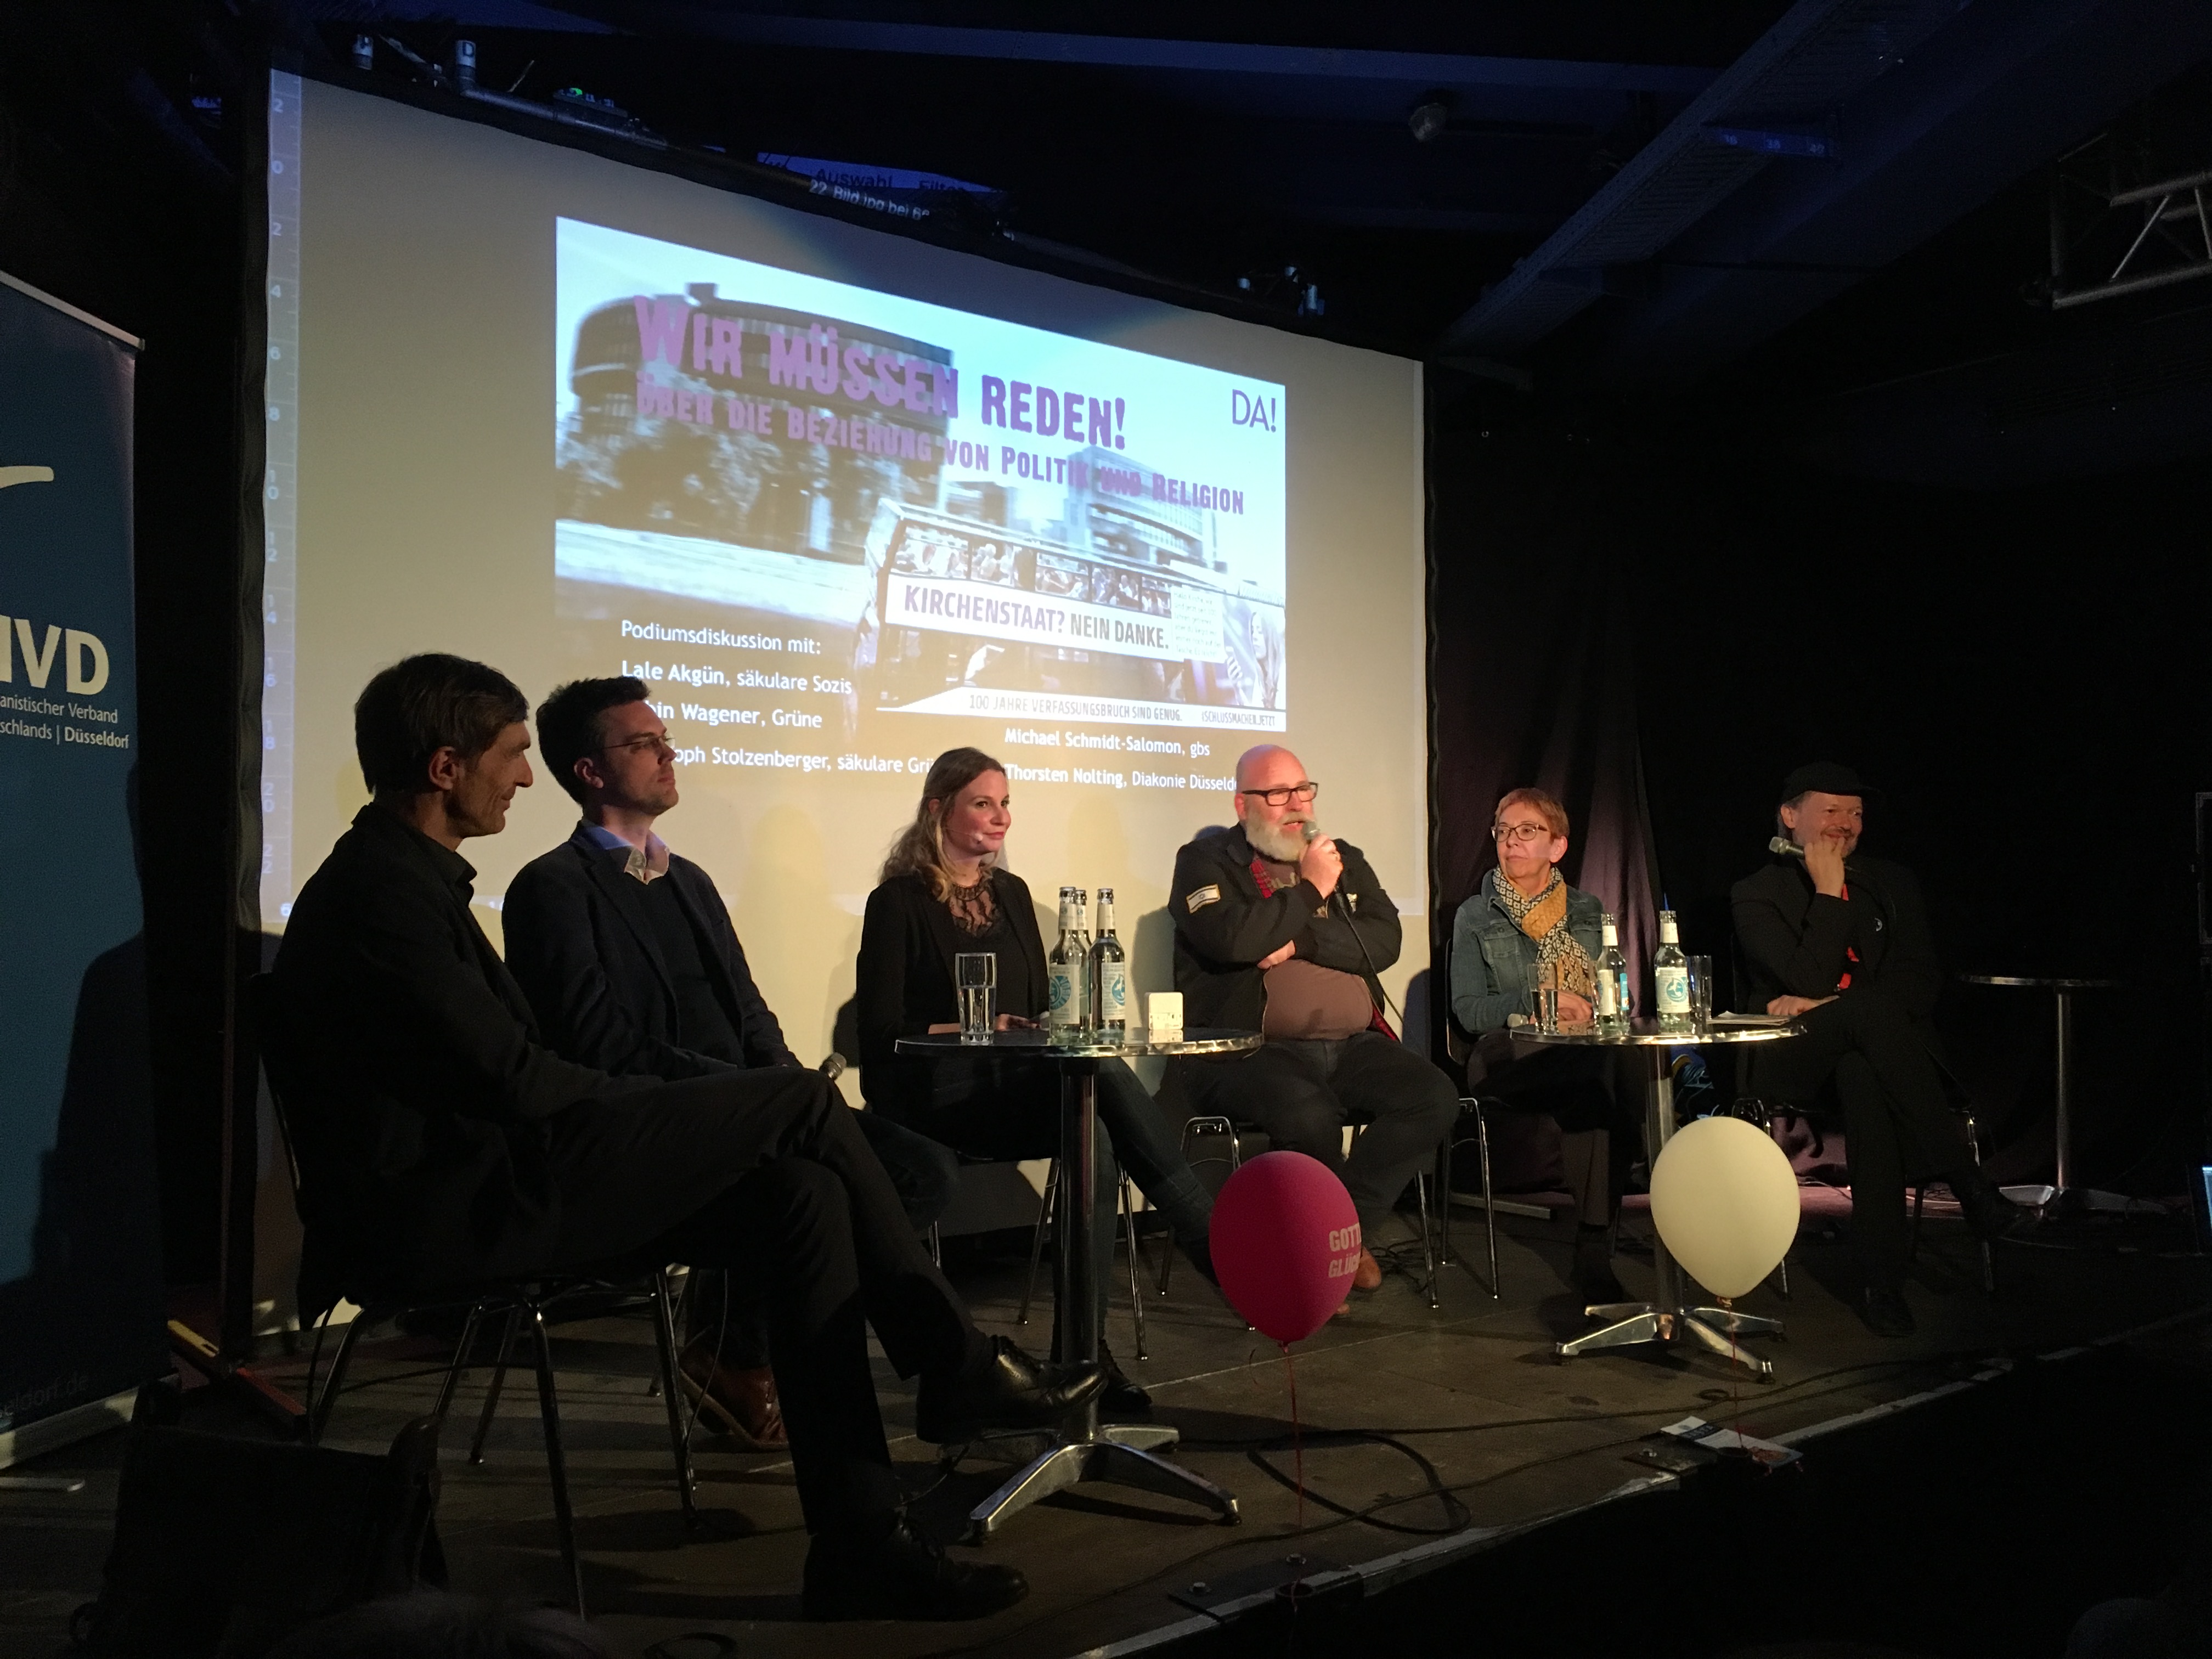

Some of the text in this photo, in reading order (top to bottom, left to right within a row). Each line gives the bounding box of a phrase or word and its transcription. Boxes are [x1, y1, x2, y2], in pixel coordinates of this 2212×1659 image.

[981, 374, 1126, 450] REDEN!
[1231, 388, 1277, 433] DA!
[728, 399, 772, 436] DIE
[787, 407, 932, 462] BEZIEHUNG
[943, 439, 989, 471] VON
[1001, 445, 1088, 489] POLITIK
[1101, 466, 1142, 497] UND
[1152, 472, 1244, 515] RELIGION
[903, 585, 1170, 650] KIRCHENSTAAT? NEIN DANKE.
[621, 619, 821, 655] Podiumsdiskussion mit:
[622, 660, 853, 695] Lale Akgün, säkulare Sozis
[68, 702, 119, 724] Verband
[681, 702, 766, 726] Wagener,
[771, 709, 822, 729] Grüne
[969, 694, 1183, 722] 100 JAHRE VERFASSUNGSBRUCH SIND GENUG.
[65, 726, 129, 749] Düsseldorf
[1004, 727, 1211, 759] Michael Schmidt-Salomon, gbs
[712, 747, 832, 772] Stolzenberger,
[837, 754, 904, 774] säkulare
[1003, 763, 1237, 792] Thorsten Nolting, Diakonie Düsseld
